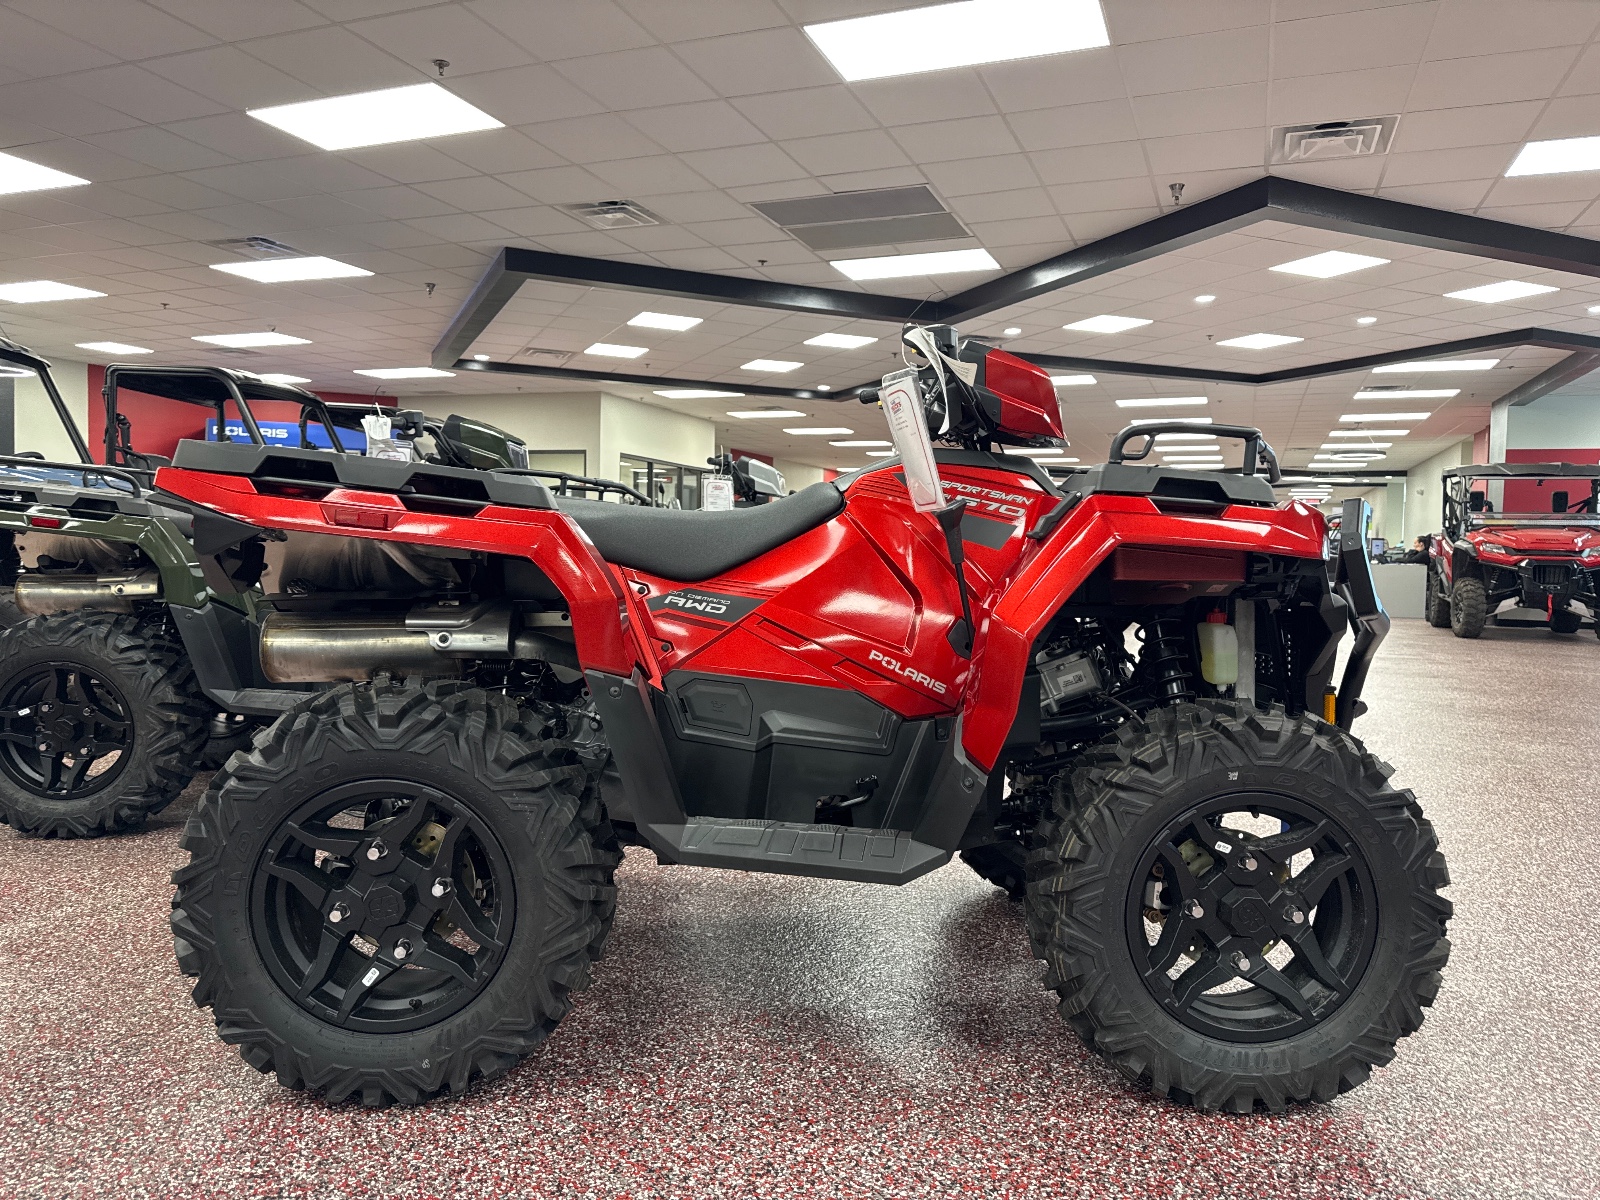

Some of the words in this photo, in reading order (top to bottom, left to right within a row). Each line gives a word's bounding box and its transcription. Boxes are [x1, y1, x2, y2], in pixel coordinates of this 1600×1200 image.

[212, 425, 289, 439] POLRIS
[940, 480, 1034, 505] SPORTSMAN
[954, 494, 1027, 517] 570
[664, 595, 727, 614] AWD
[668, 589, 684, 597] ON
[687, 593, 731, 605] DEMAND
[868, 649, 947, 694] POLARIS
